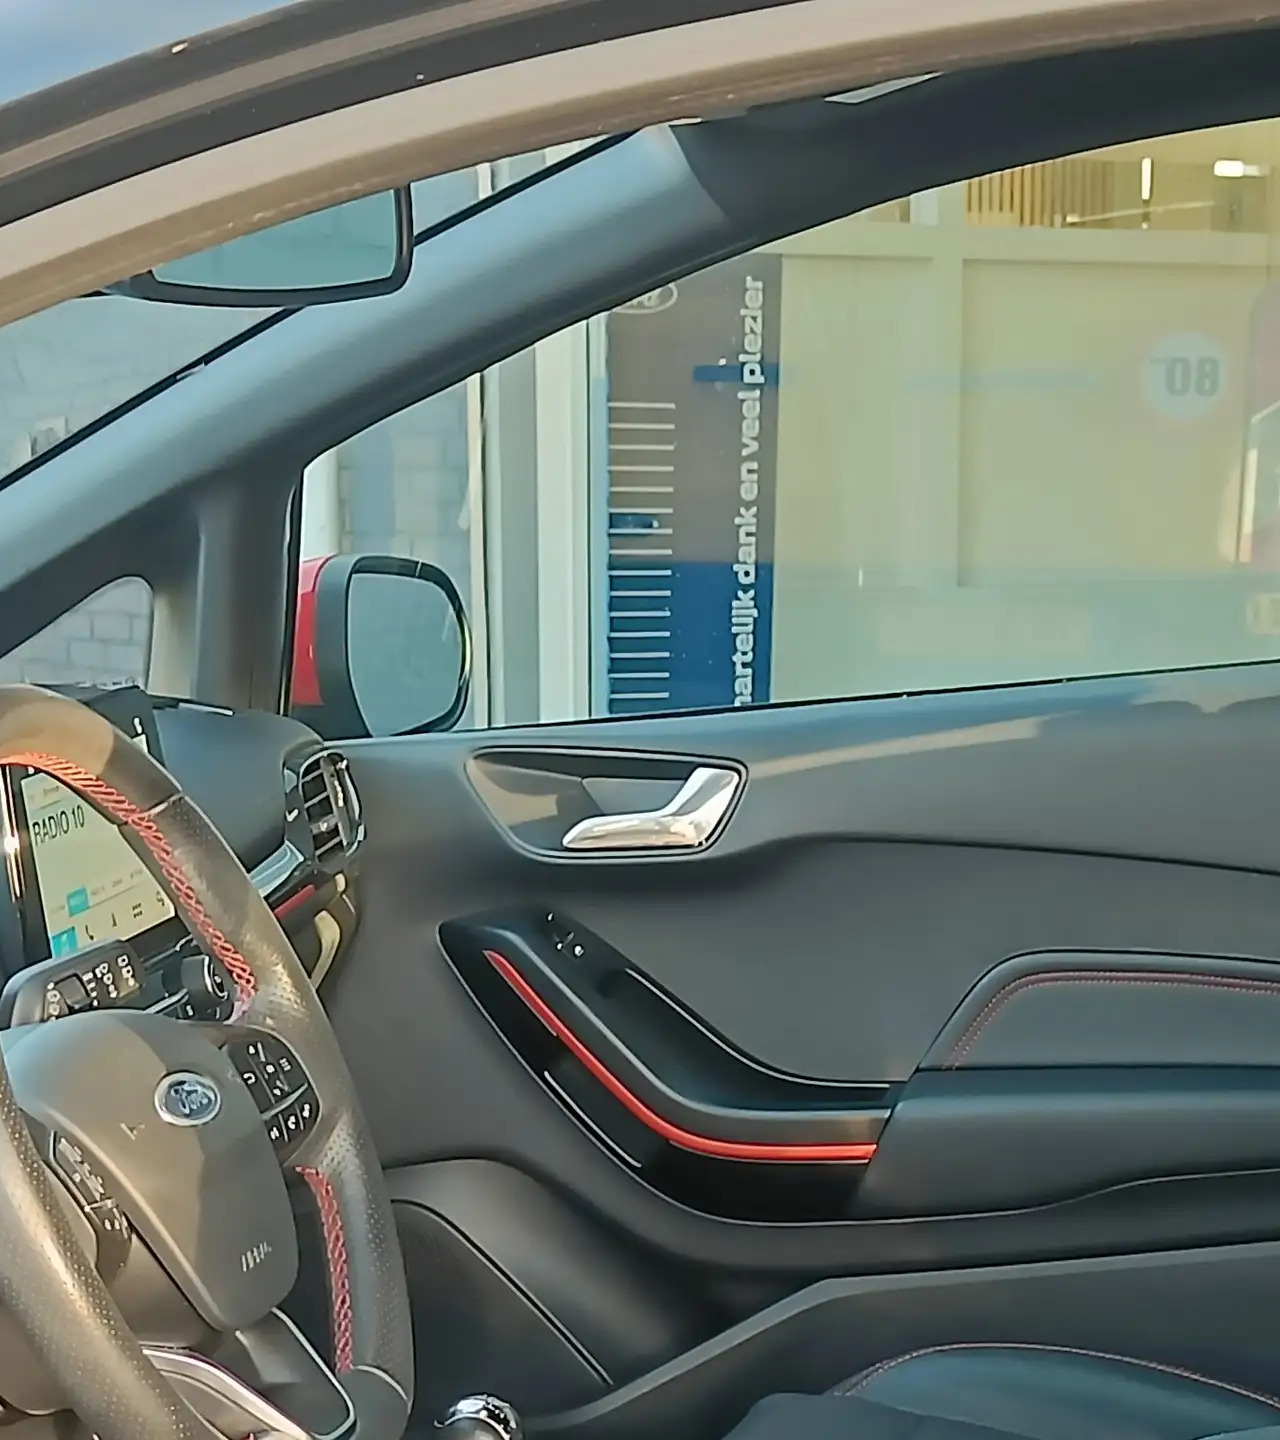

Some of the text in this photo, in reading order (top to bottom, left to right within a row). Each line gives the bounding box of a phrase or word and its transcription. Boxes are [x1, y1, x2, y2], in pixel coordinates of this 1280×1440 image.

[738, 275, 765, 384] plezier
[737, 389, 761, 456] veel
[740, 461, 759, 501] en
[732, 506, 758, 585] dank
[32, 804, 86, 846] RADIO 10
